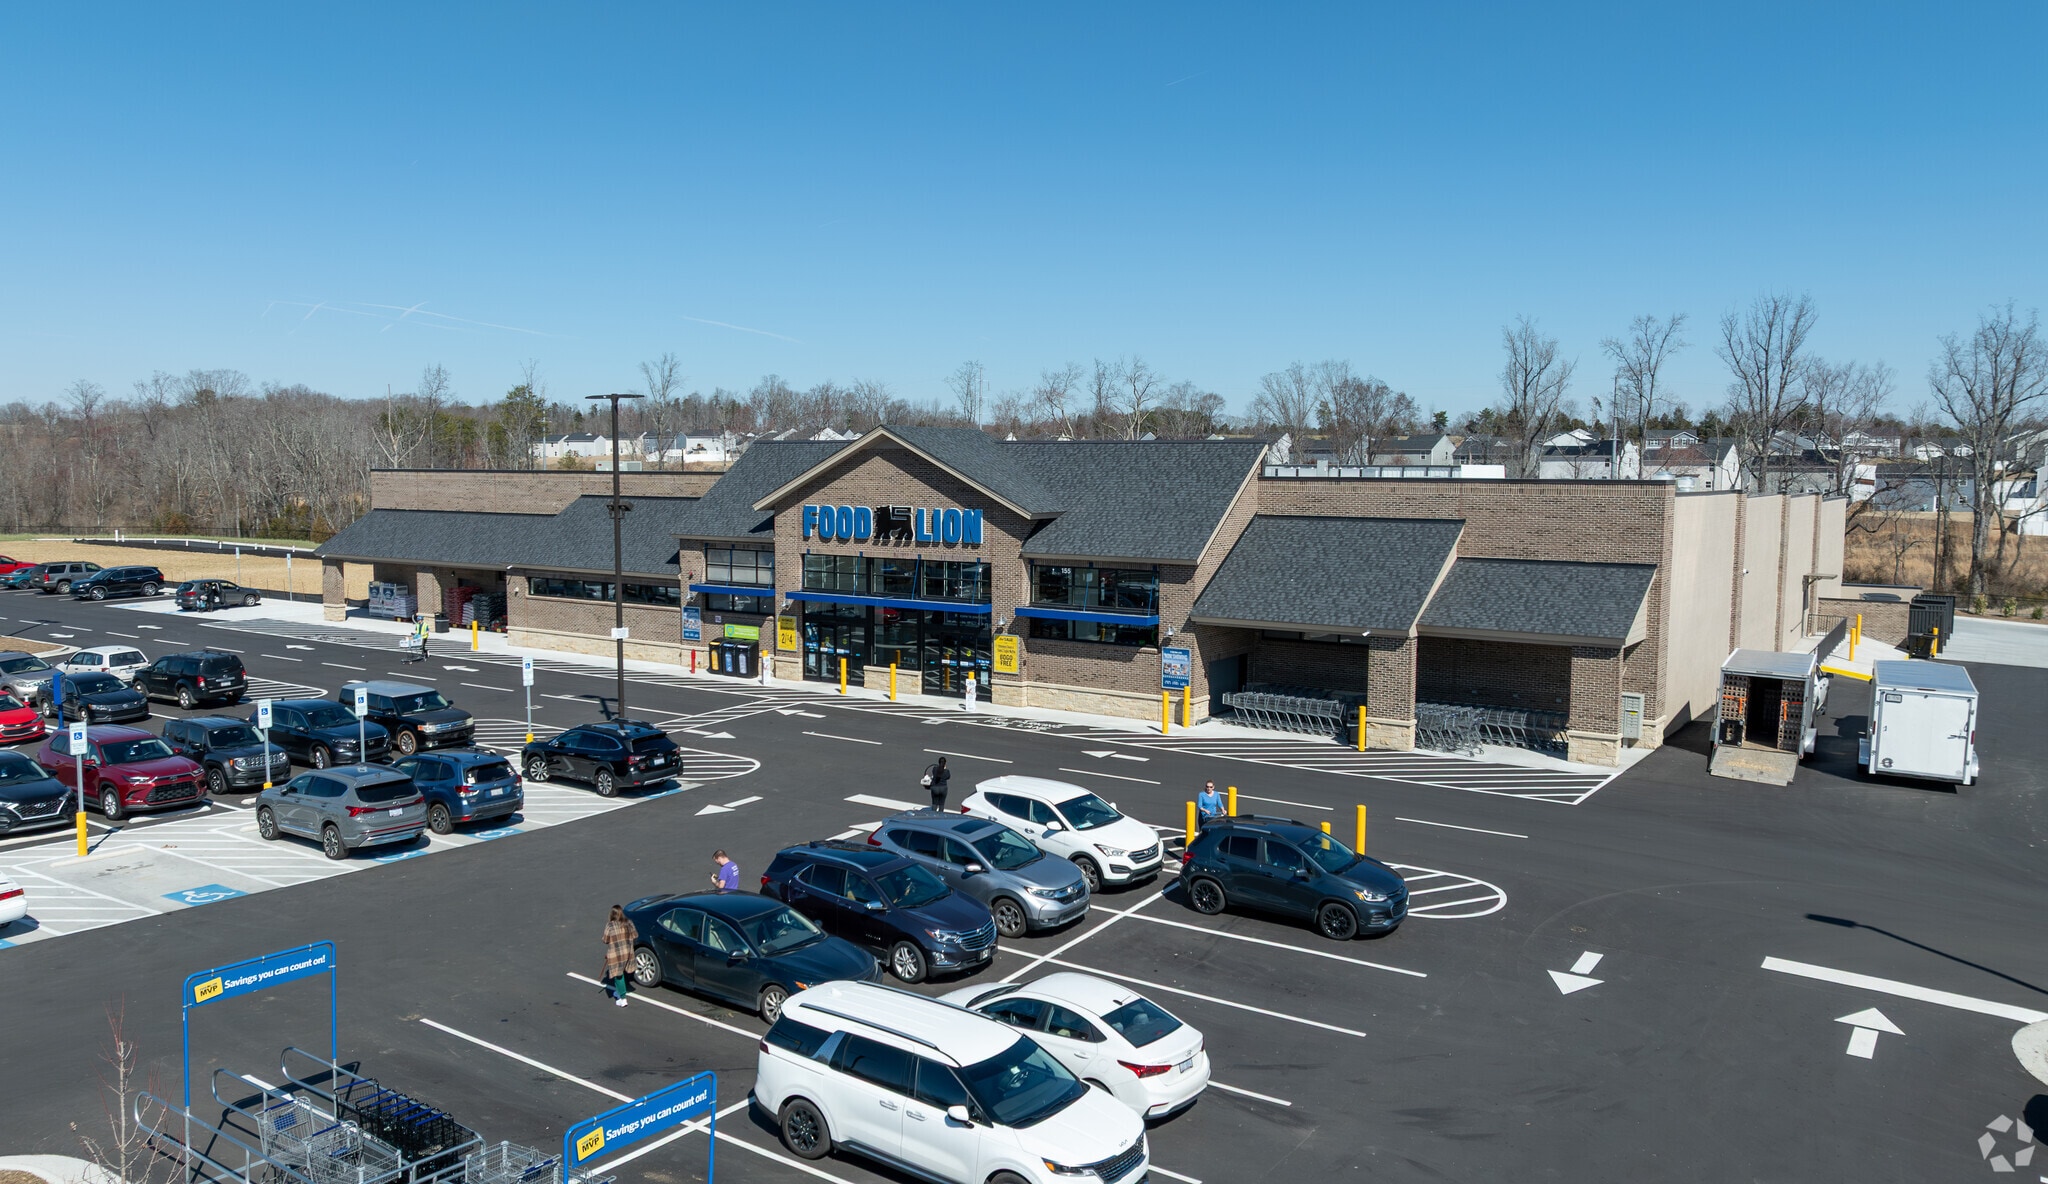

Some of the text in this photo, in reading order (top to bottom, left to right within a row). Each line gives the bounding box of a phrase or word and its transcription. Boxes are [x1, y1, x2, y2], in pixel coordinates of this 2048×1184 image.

[803, 504, 984, 545] FOOD LION
[224, 974, 258, 989] Savings
[258, 970, 274, 982] you
[274, 966, 289, 976] can
[290, 959, 313, 971] count
[313, 954, 326, 966] on!
[200, 985, 218, 997] MVP
[606, 1120, 640, 1141] Savings
[640, 1113, 656, 1129] you
[657, 1107, 672, 1119] can
[672, 1096, 695, 1113] count
[695, 1089, 708, 1103] on!
[581, 1137, 600, 1153] MVP
